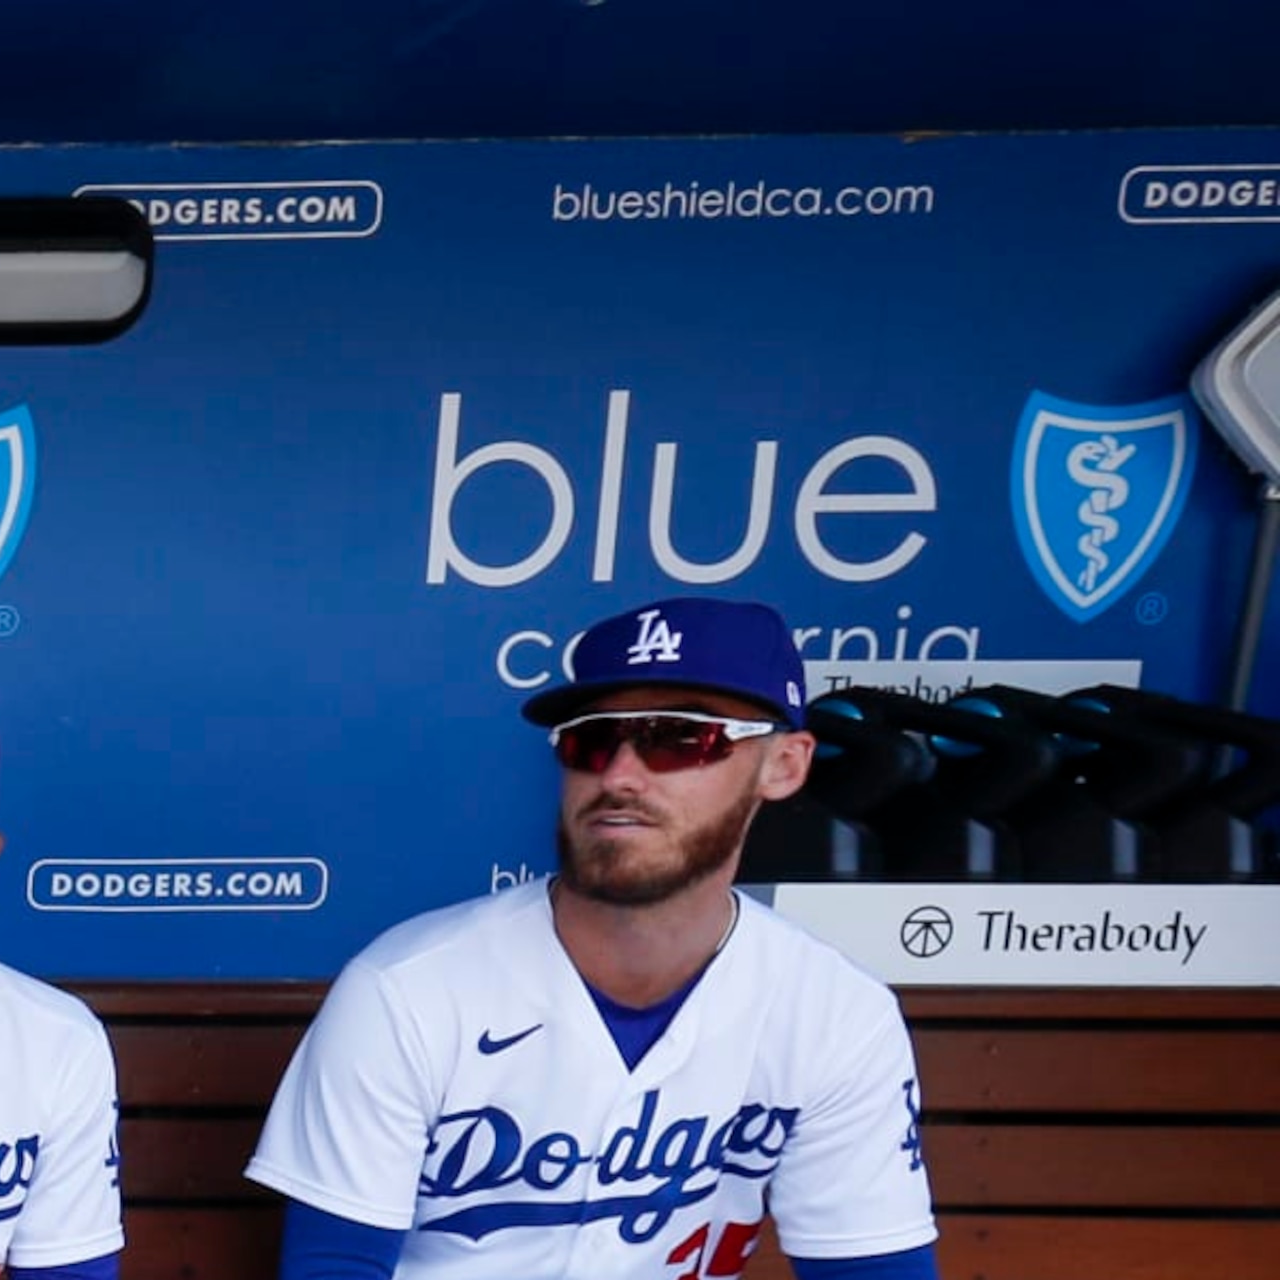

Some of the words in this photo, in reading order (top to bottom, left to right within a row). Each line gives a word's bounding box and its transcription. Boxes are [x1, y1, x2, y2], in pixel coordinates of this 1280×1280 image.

[132, 195, 358, 226] DGERS.COM
[552, 181, 935, 221] blueshieldca.com
[1143, 179, 1280, 209] DODGE
[425, 389, 938, 588] blue
[627, 609, 683, 665] LA
[51, 872, 303, 897] DODGERS.COM
[977, 910, 1208, 965] Therabody
